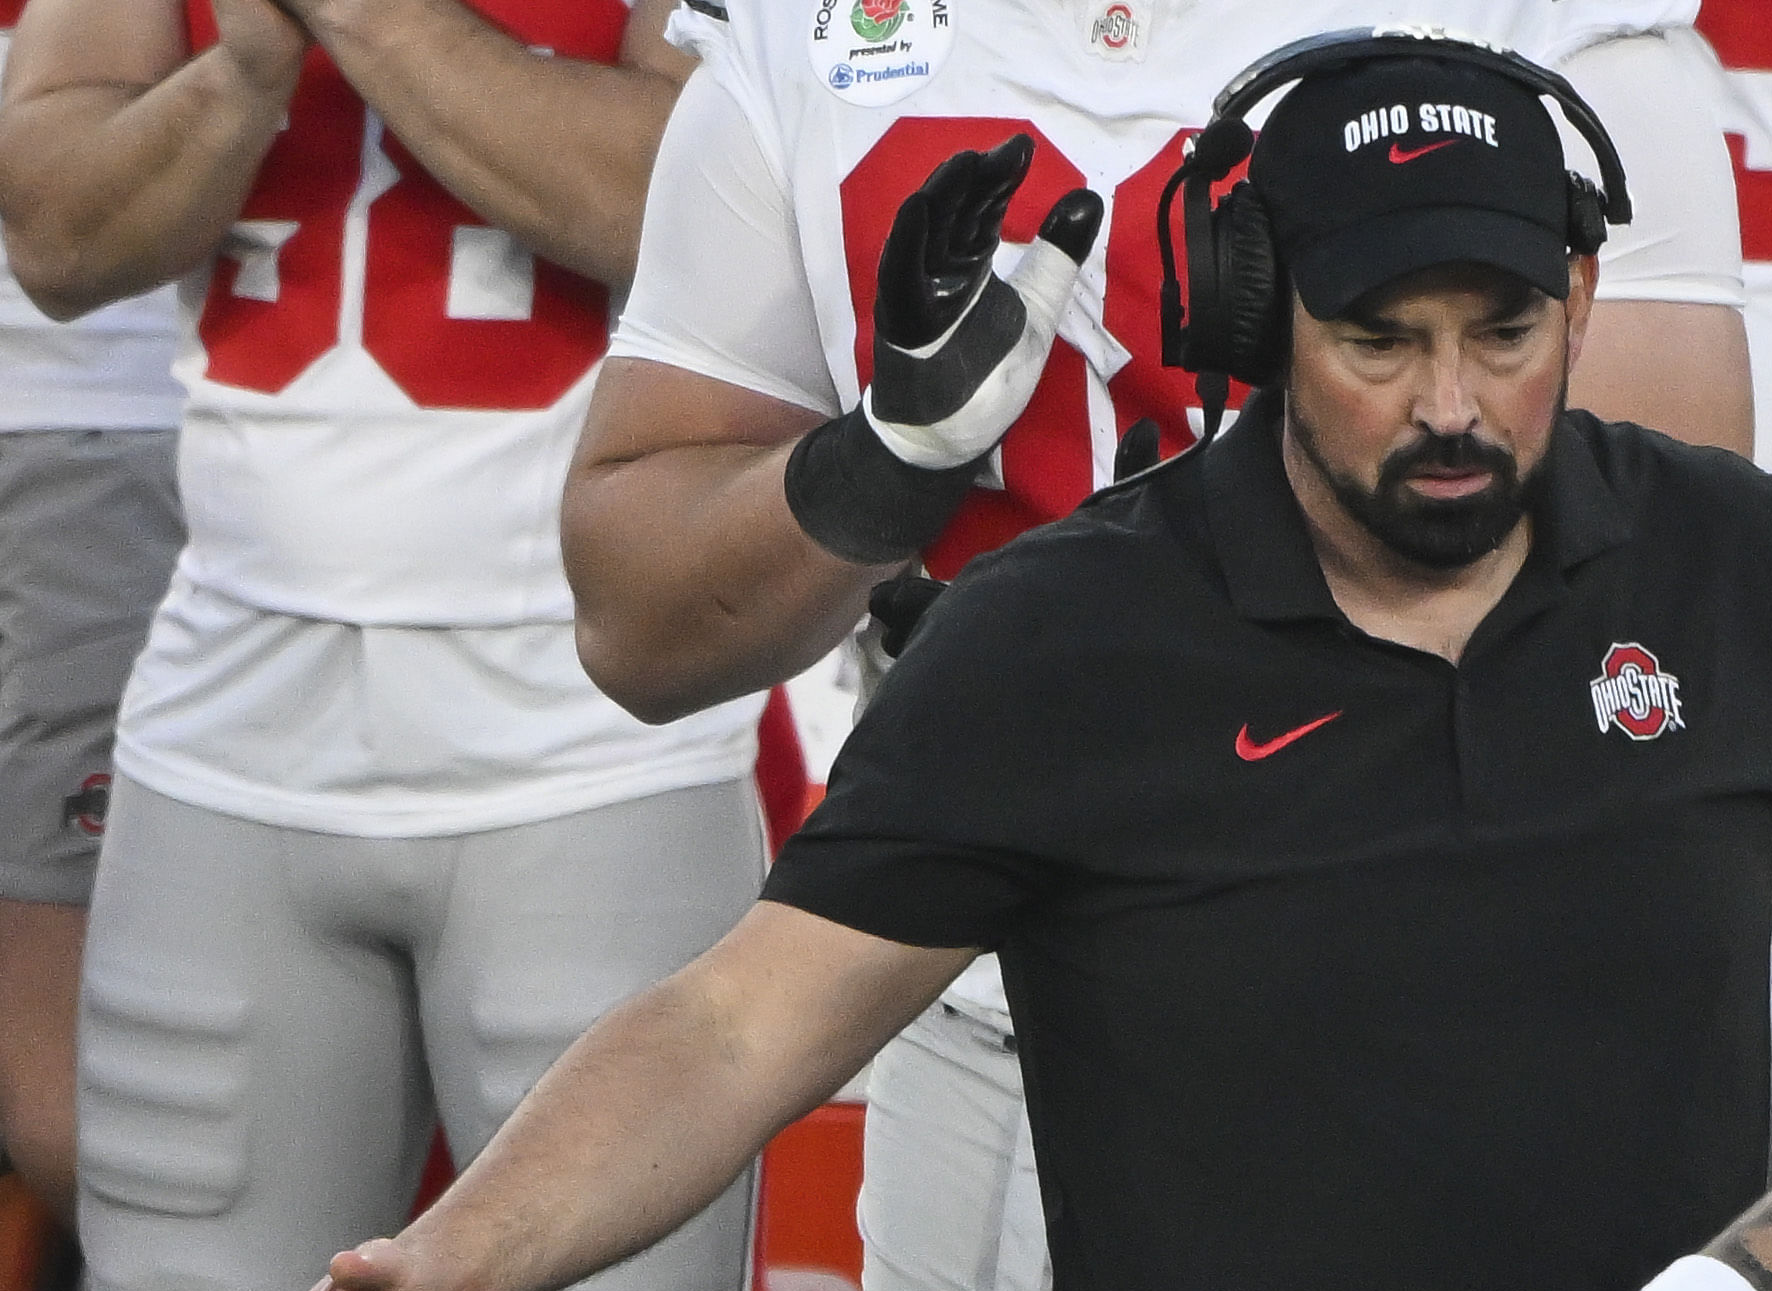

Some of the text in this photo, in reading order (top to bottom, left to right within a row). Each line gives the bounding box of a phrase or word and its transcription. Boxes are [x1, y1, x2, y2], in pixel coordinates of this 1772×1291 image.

[848, 40, 913, 60] presented by
[856, 62, 930, 83] Prudential
[1343, 103, 1499, 153] OHIO STATE
